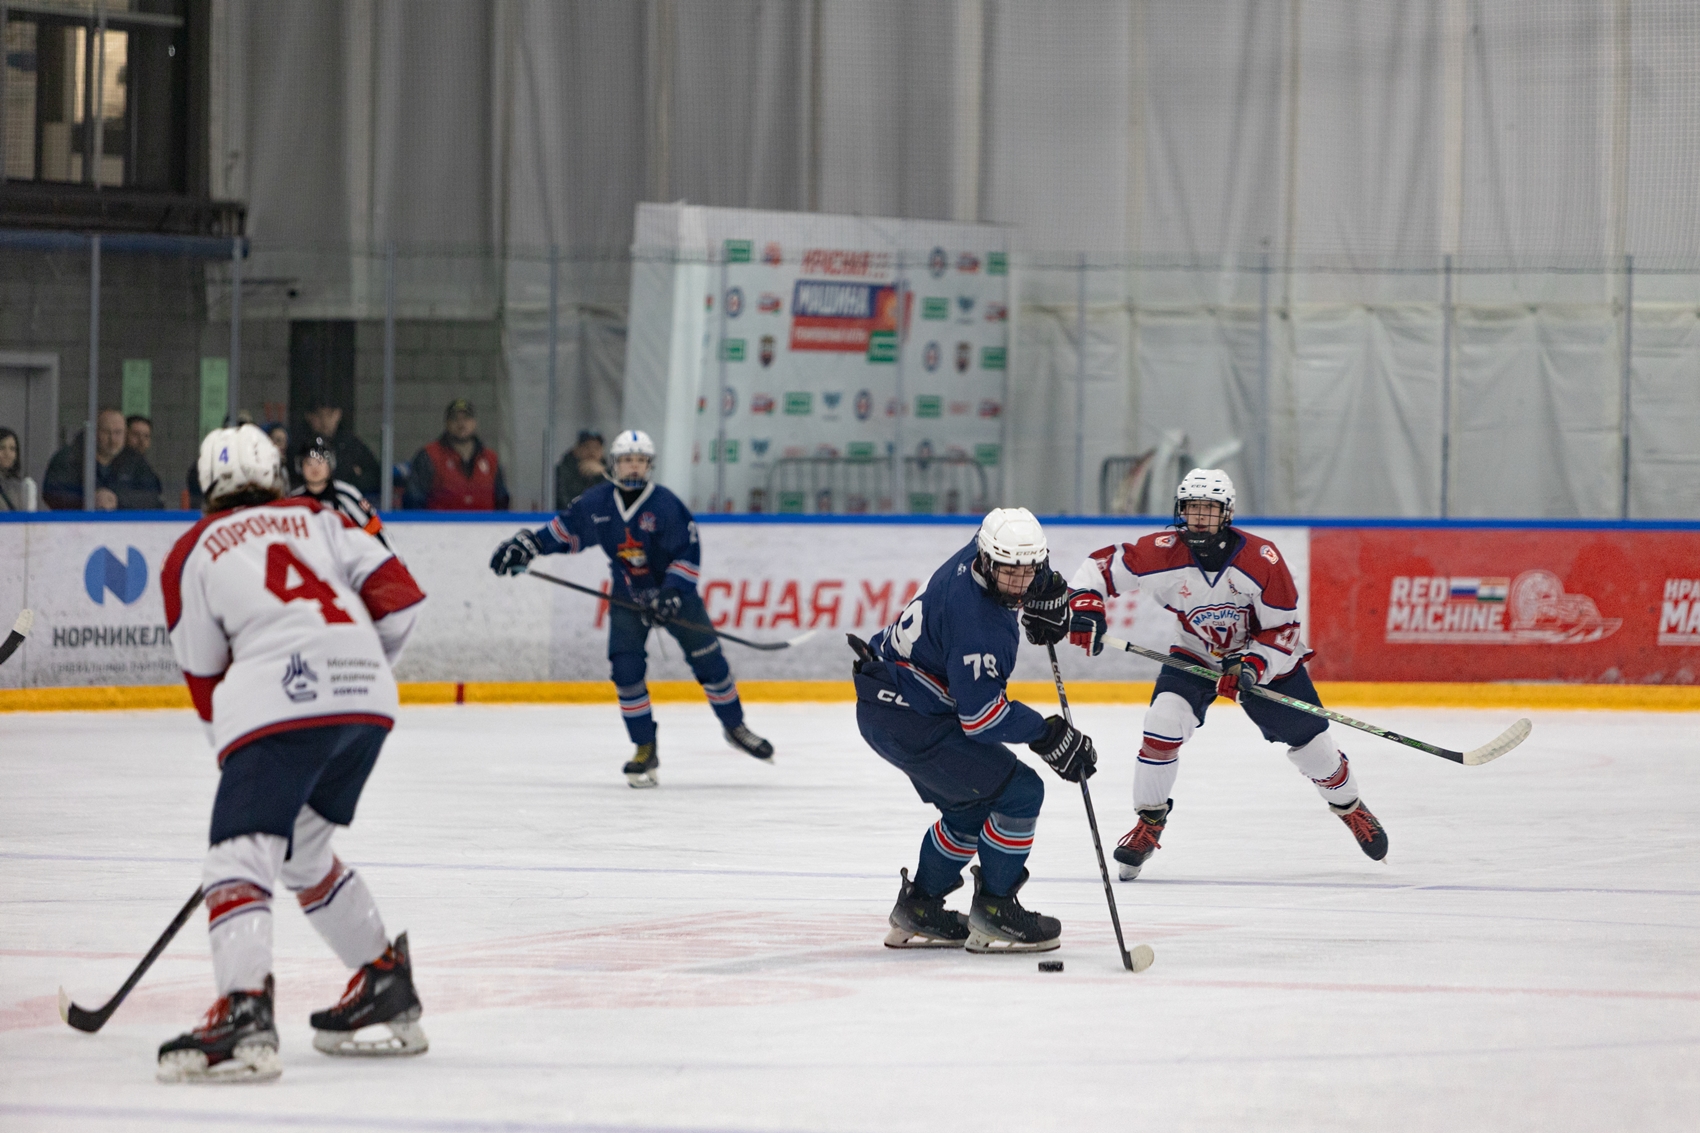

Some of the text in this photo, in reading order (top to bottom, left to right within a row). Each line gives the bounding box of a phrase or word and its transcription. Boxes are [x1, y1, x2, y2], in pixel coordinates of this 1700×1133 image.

[218, 446, 229, 464] 4
[203, 514, 309, 562] ДОРОНИН
[265, 542, 356, 624] 4
[1391, 577, 1447, 603] RED
[595, 580, 844, 628] СНАЯ
[1193, 609, 1240, 626] МАРЬИНО
[1386, 603, 1506, 632] MACHINE
[53, 626, 174, 647] НОРНИКЕЛ
[1052, 661, 1065, 695] CCM
